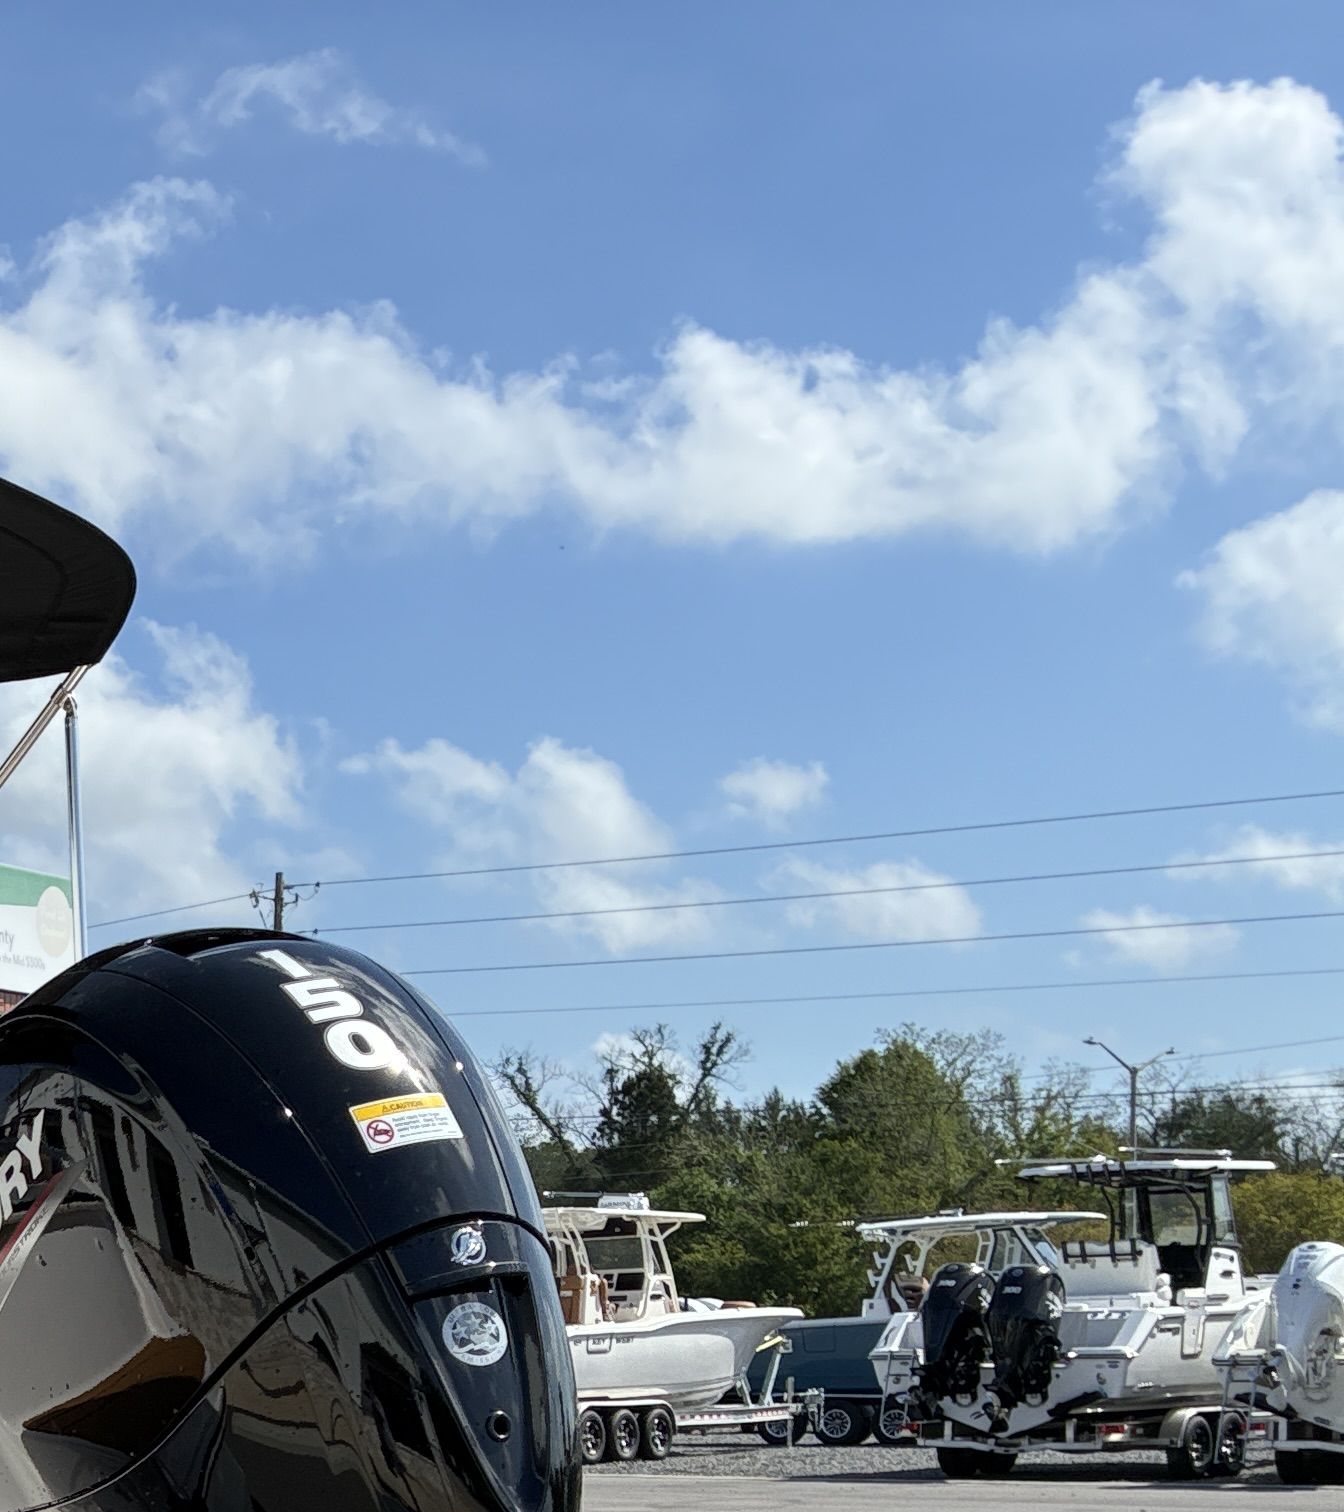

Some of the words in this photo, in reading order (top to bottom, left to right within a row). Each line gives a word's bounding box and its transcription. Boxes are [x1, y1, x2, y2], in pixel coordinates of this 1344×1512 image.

[2, 951, 12, 964] the
[255, 949, 402, 1071] 150
[389, 1100, 424, 1111] CAUTION
